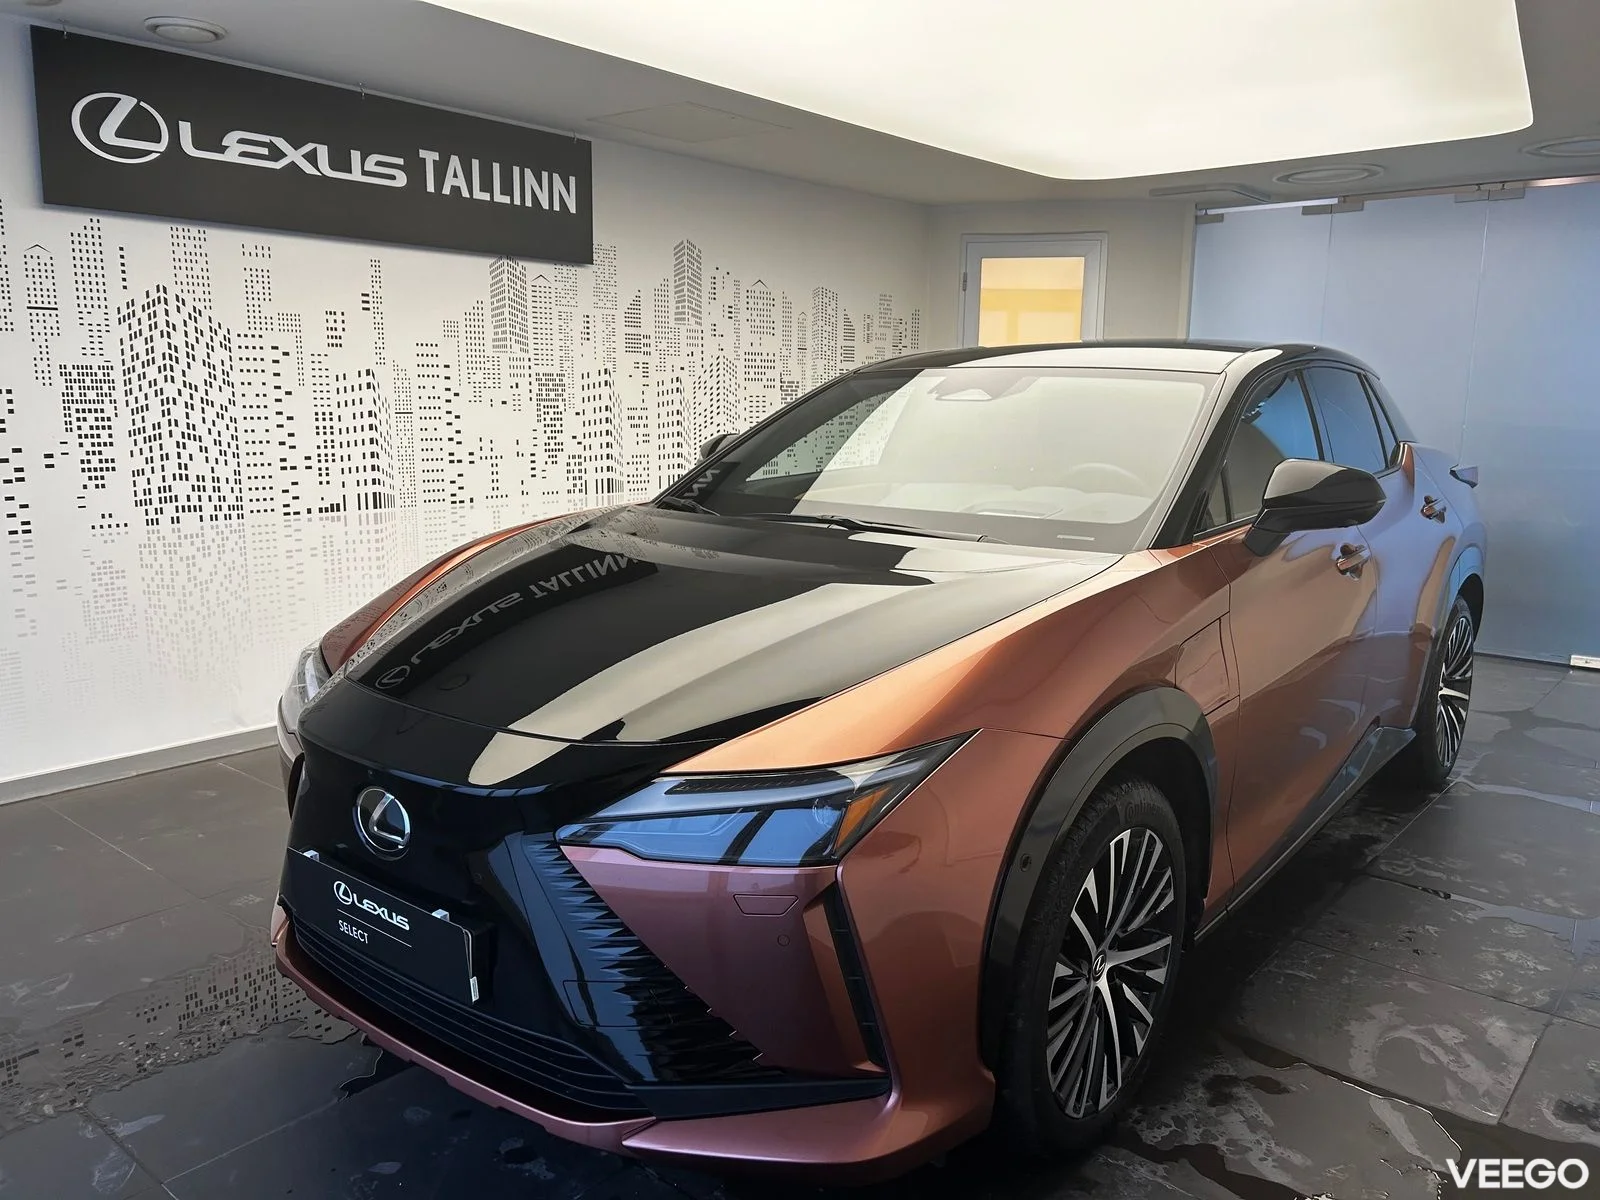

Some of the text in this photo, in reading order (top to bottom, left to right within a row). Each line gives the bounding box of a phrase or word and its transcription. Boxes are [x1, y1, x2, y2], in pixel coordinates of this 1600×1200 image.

[178, 120, 577, 214] LEXUS TALLINN
[352, 892, 410, 931] LEXUS
[338, 919, 369, 945] SELECT
